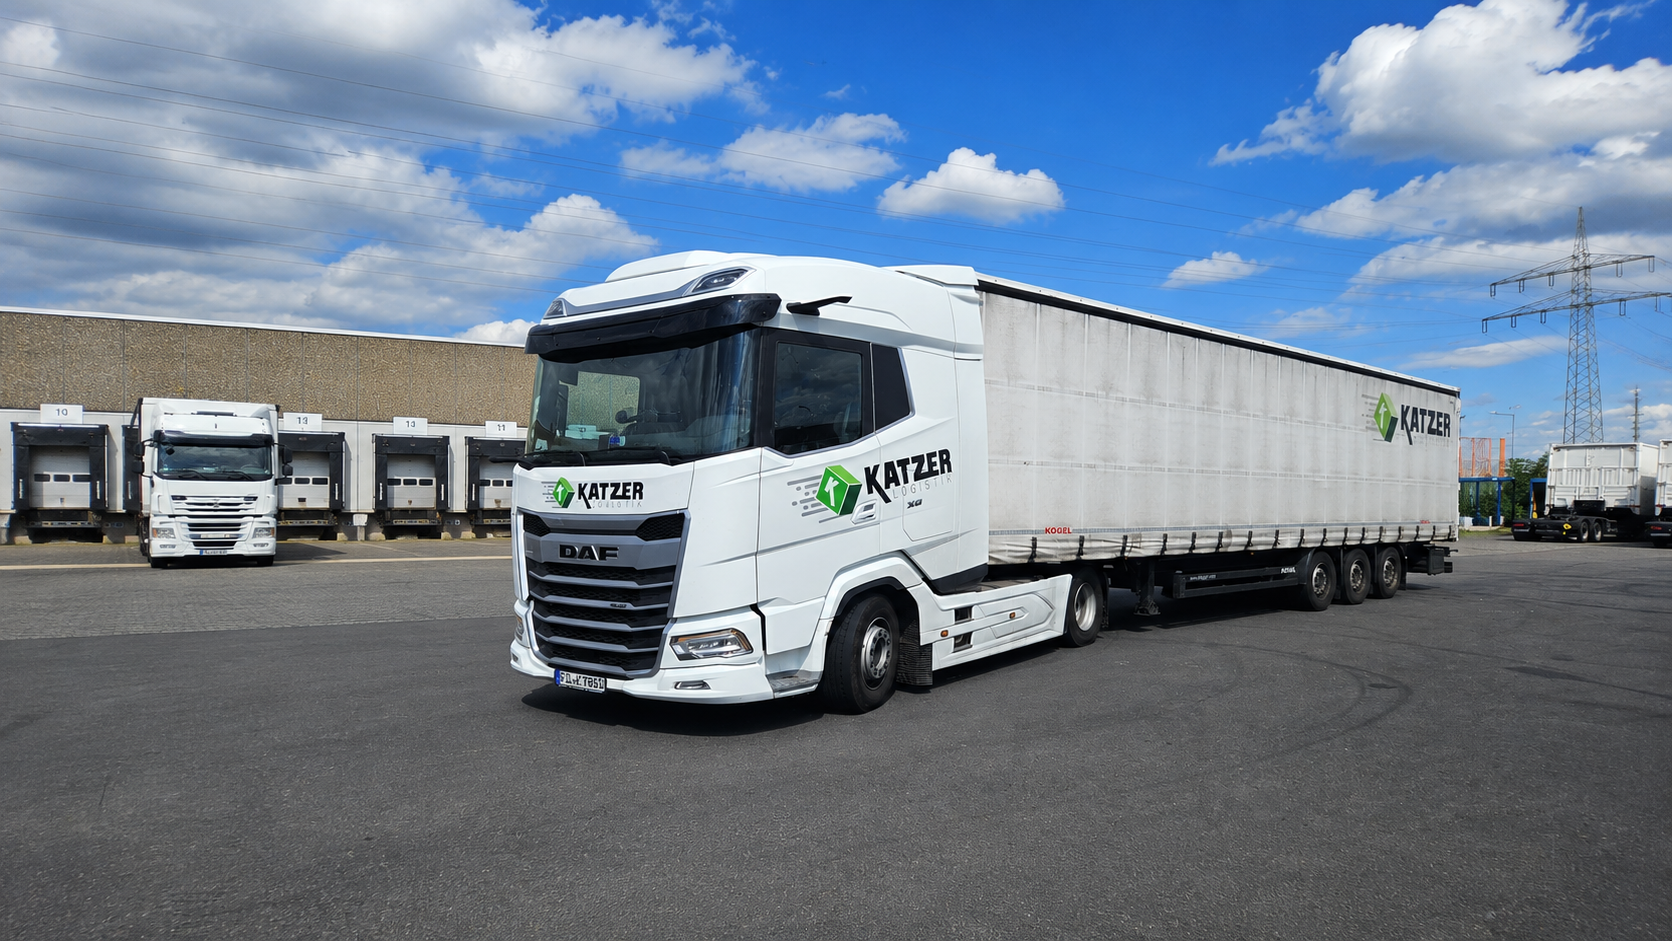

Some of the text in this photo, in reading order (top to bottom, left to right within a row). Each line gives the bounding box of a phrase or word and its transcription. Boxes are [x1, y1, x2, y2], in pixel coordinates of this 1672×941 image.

[1400, 404, 1451, 446] KATZER
[864, 448, 952, 505] KATZER
[892, 474, 953, 500] LOGISTIK
[578, 482, 644, 509] KATZER
[559, 544, 619, 561] DAF
